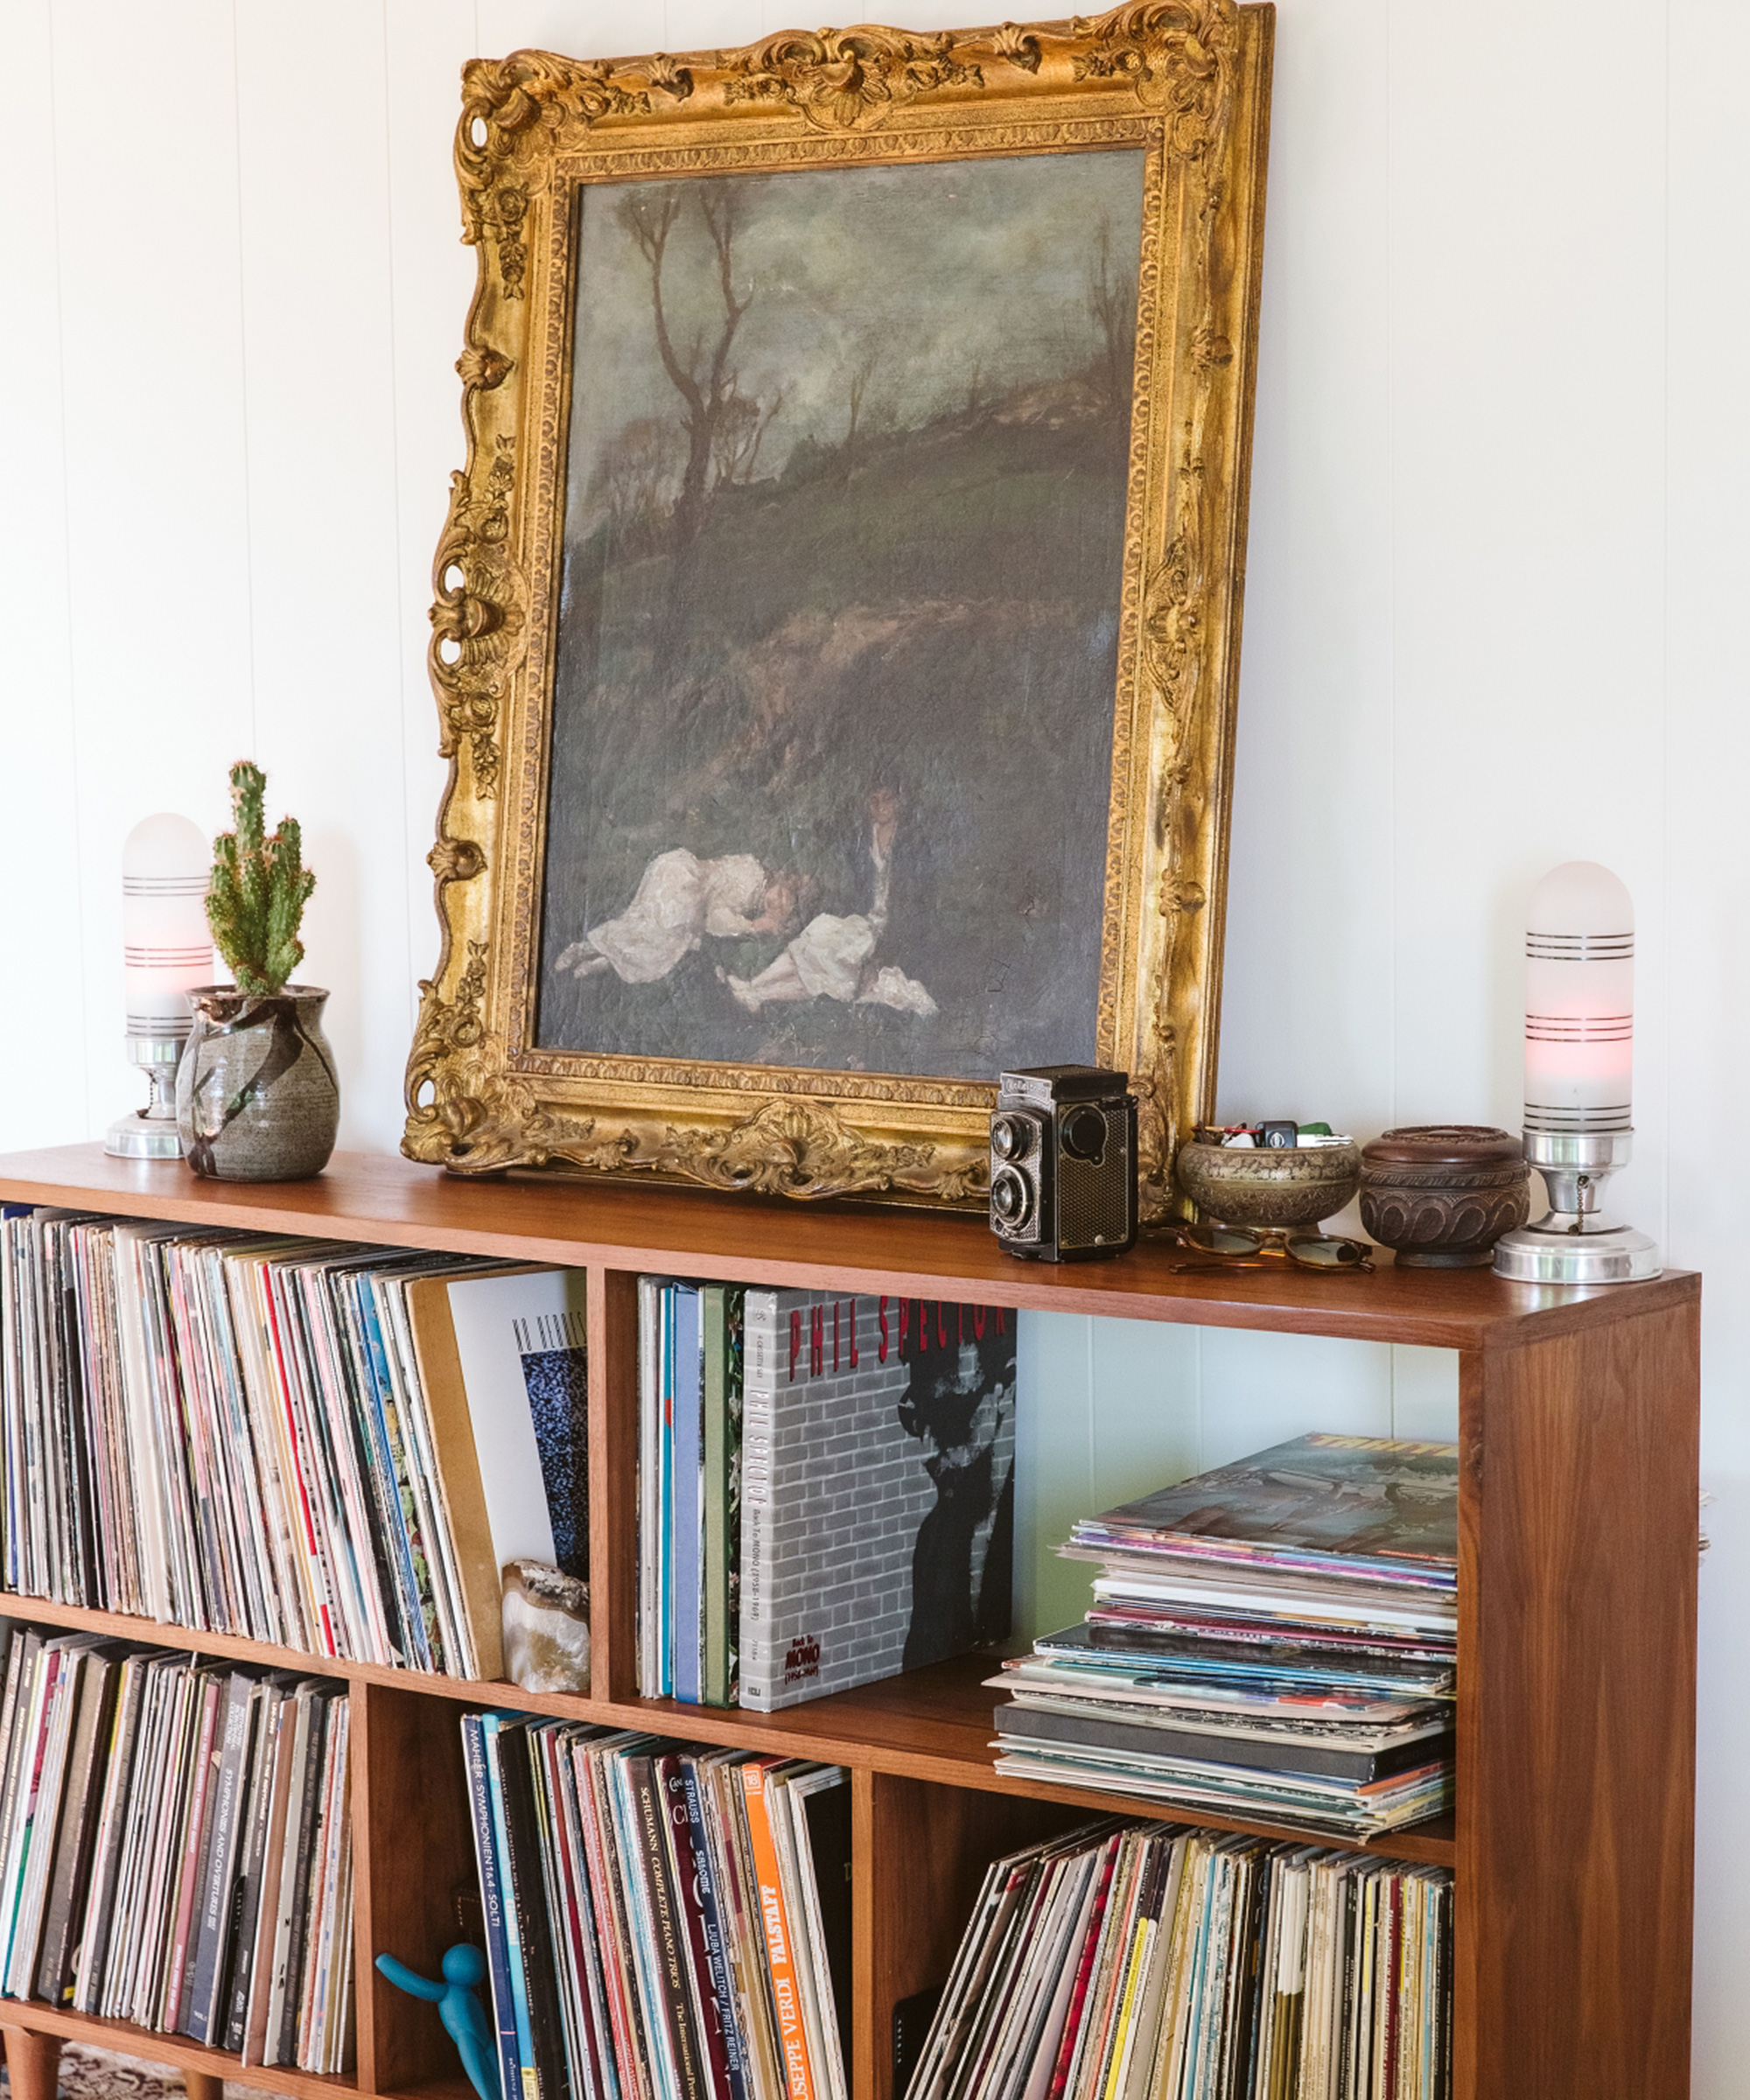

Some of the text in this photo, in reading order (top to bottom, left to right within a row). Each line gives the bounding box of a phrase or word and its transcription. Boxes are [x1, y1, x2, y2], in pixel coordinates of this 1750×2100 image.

[790, 1298, 859, 1382] PHIL
[747, 1390, 769, 1504] PHIL SPECTOR
[751, 1538, 760, 1566] MONO
[785, 1643, 820, 1670] MONO
[467, 1728, 484, 1782] MAHLER
[217, 1768, 234, 1831] SYMPHONIES
[683, 1778, 699, 1823] STRAUSS
[746, 1774, 759, 1787] 18
[475, 1783, 493, 1865] SYMPHONIEN
[640, 1786, 659, 1852] SCHUMANN
[215, 1831, 226, 1857] AND
[209, 1858, 223, 1914] OVERTURES
[651, 1856, 669, 1918] COMPLETE
[486, 1893, 500, 1928] SOLTI
[761, 1885, 787, 1964] FALSTAFF
[661, 1918, 675, 1956] PIANO
[706, 1922, 720, 1952] LJUBA
[665, 1954, 682, 1989] TRIOS
[711, 1954, 728, 1998] WELITCH
[675, 2002, 685, 2021] The
[720, 2006, 734, 2034] FRITZ
[775, 1977, 798, 2035] VERDI
[724, 2034, 739, 2071] REINER
